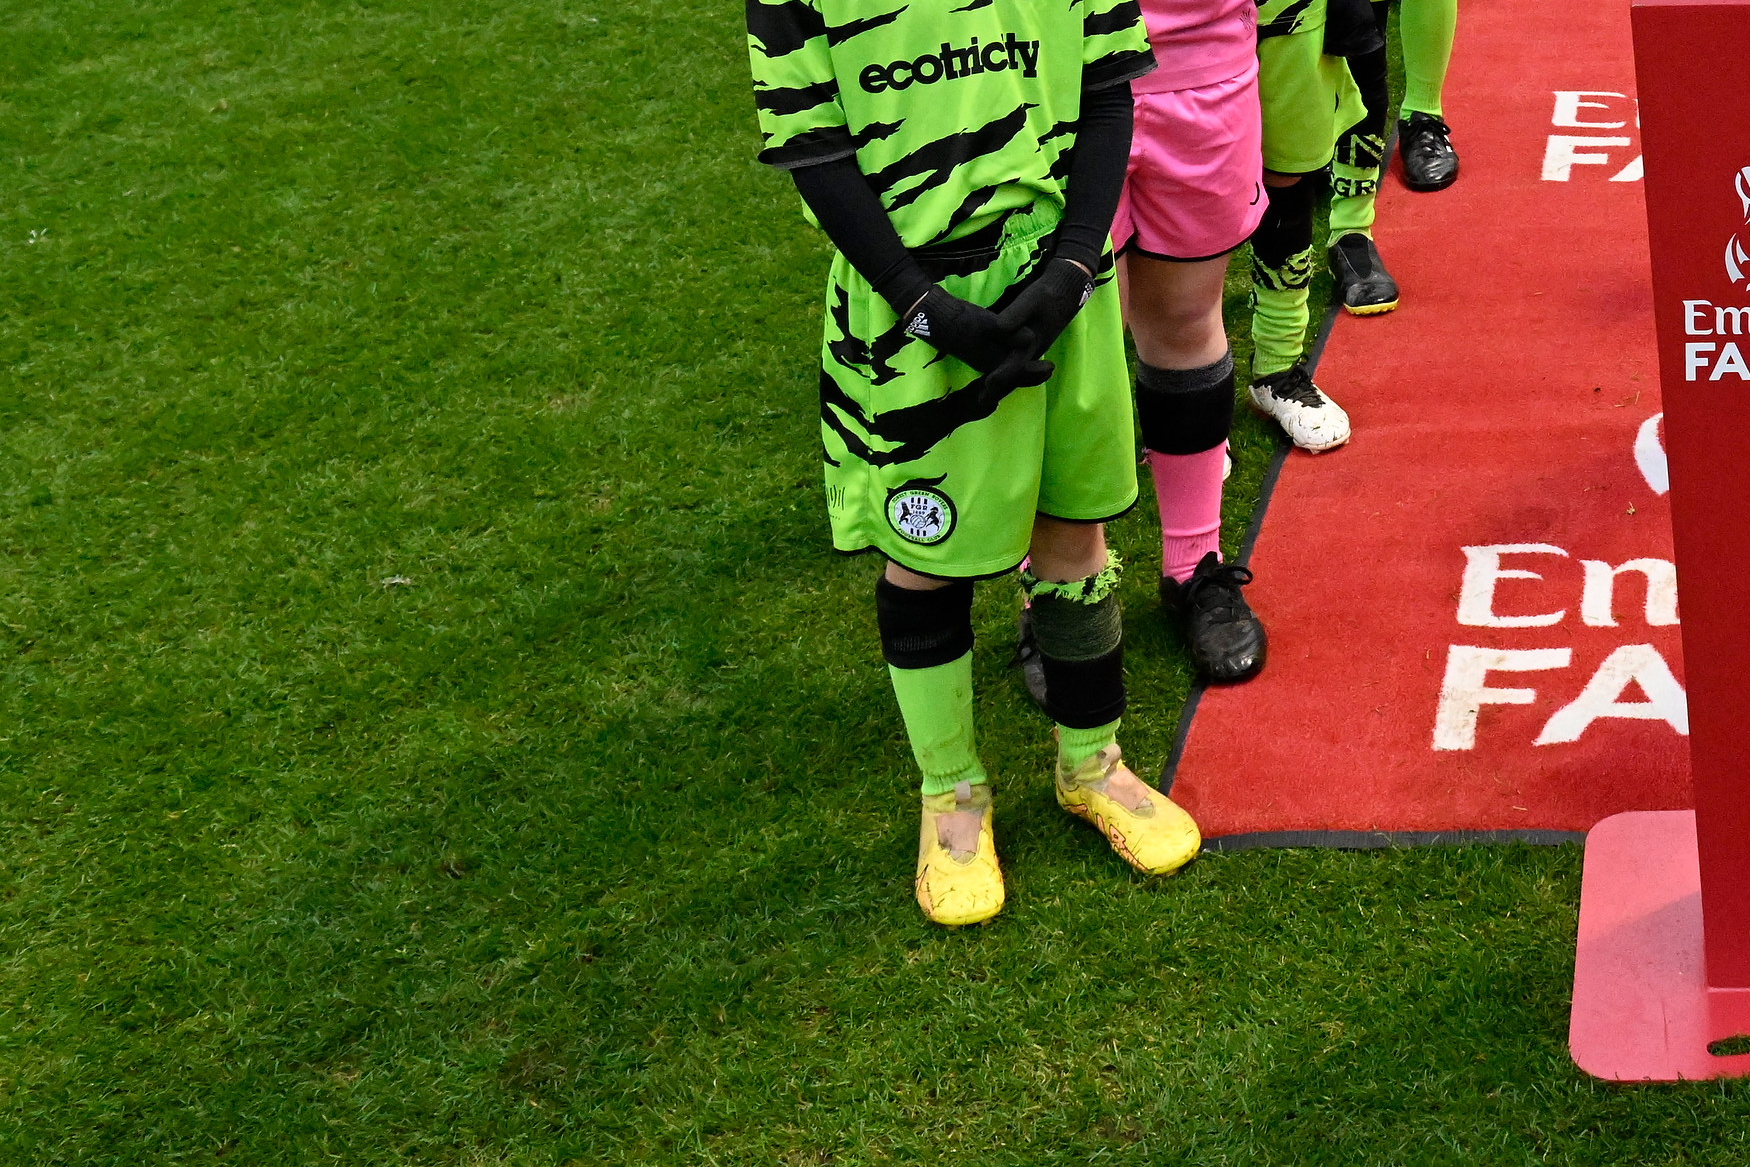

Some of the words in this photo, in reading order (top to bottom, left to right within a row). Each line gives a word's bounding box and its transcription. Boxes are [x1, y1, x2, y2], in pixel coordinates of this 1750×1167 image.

[858, 32, 1040, 94] ecotricty
[910, 503, 928, 511] FGR
[1431, 642, 1690, 752] FA
